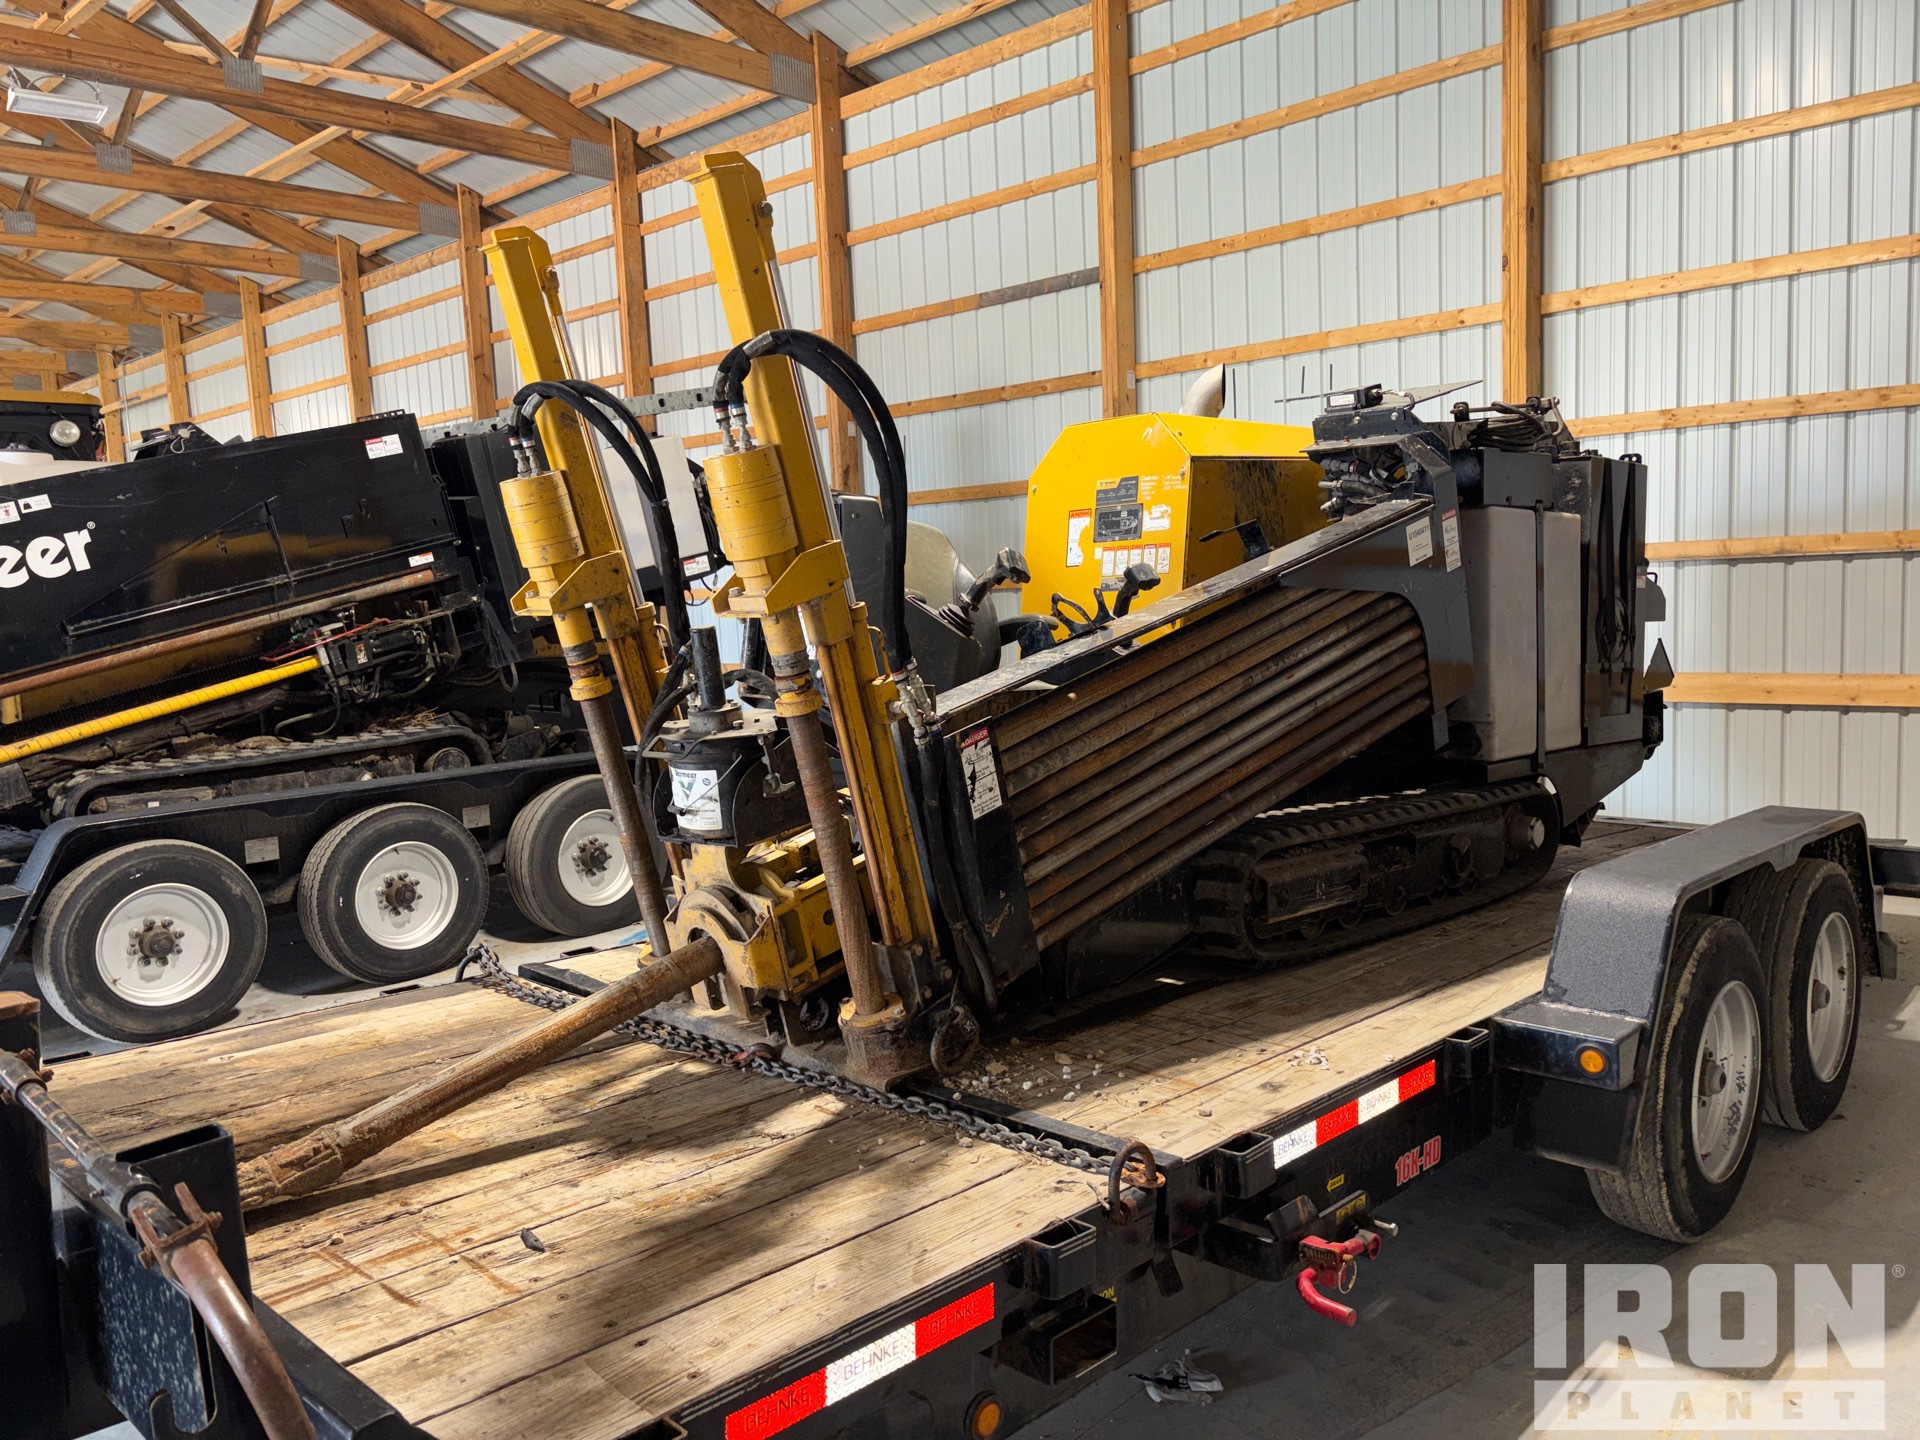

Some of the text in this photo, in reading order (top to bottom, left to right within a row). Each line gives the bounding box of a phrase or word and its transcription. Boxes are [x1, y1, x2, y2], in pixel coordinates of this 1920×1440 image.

[1278, 1132, 1309, 1155] BEHNKE
[1366, 1088, 1391, 1108] BEHNKE
[1395, 1135, 1441, 1187] 16K-HD
[843, 1340, 899, 1382] BEHNKE
[927, 1301, 980, 1337] BEHNKE
